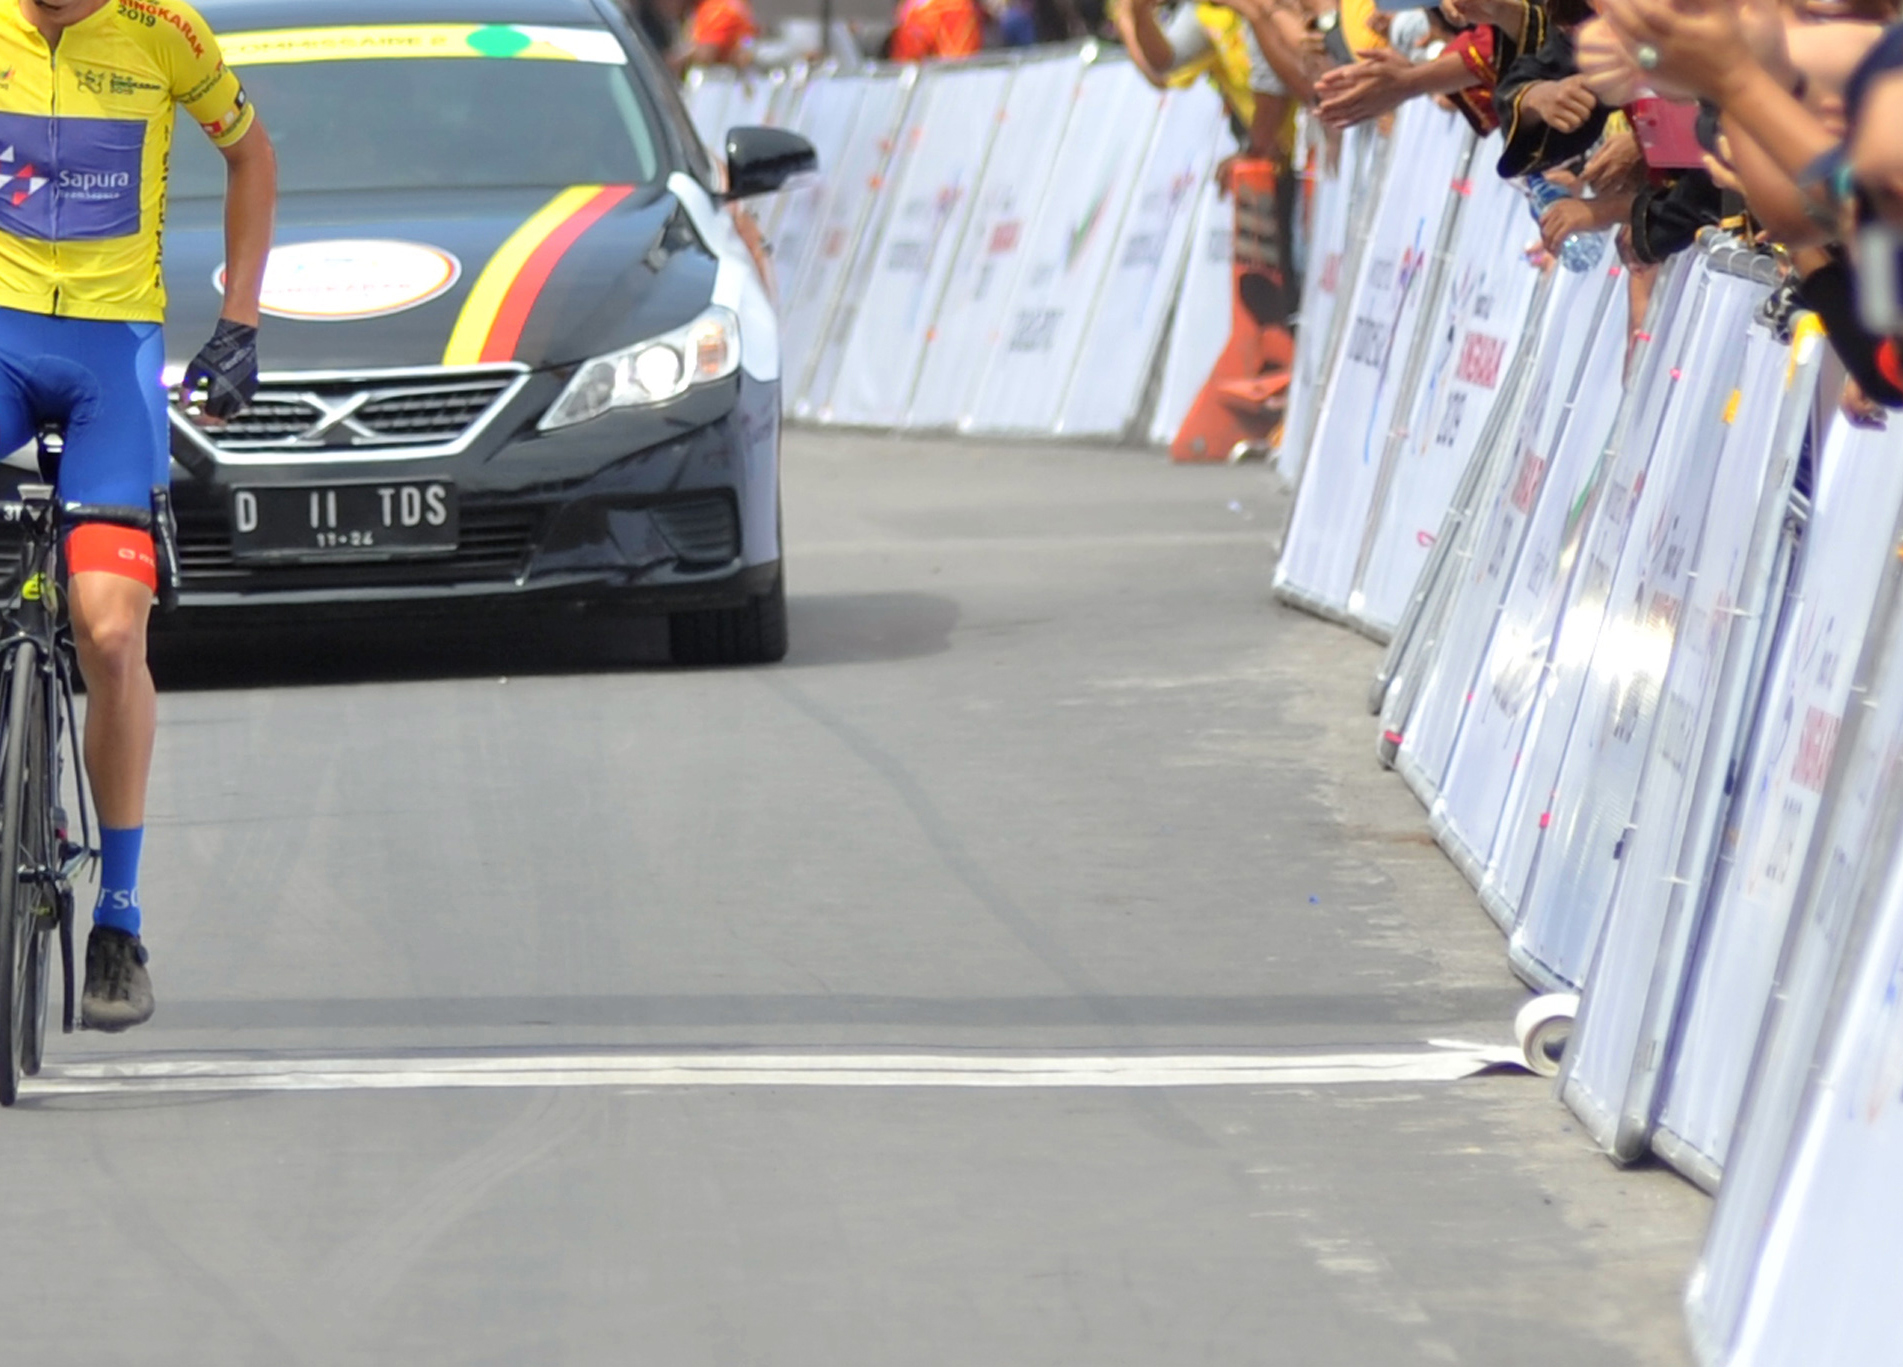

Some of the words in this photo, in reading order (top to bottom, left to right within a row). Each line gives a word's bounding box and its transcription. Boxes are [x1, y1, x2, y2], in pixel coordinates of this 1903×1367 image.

[117, 4, 157, 29] 2019
[59, 169, 130, 192] Sapura
[3, 504, 23, 522] 3T
[235, 491, 258, 533] D
[378, 484, 447, 527] TDS
